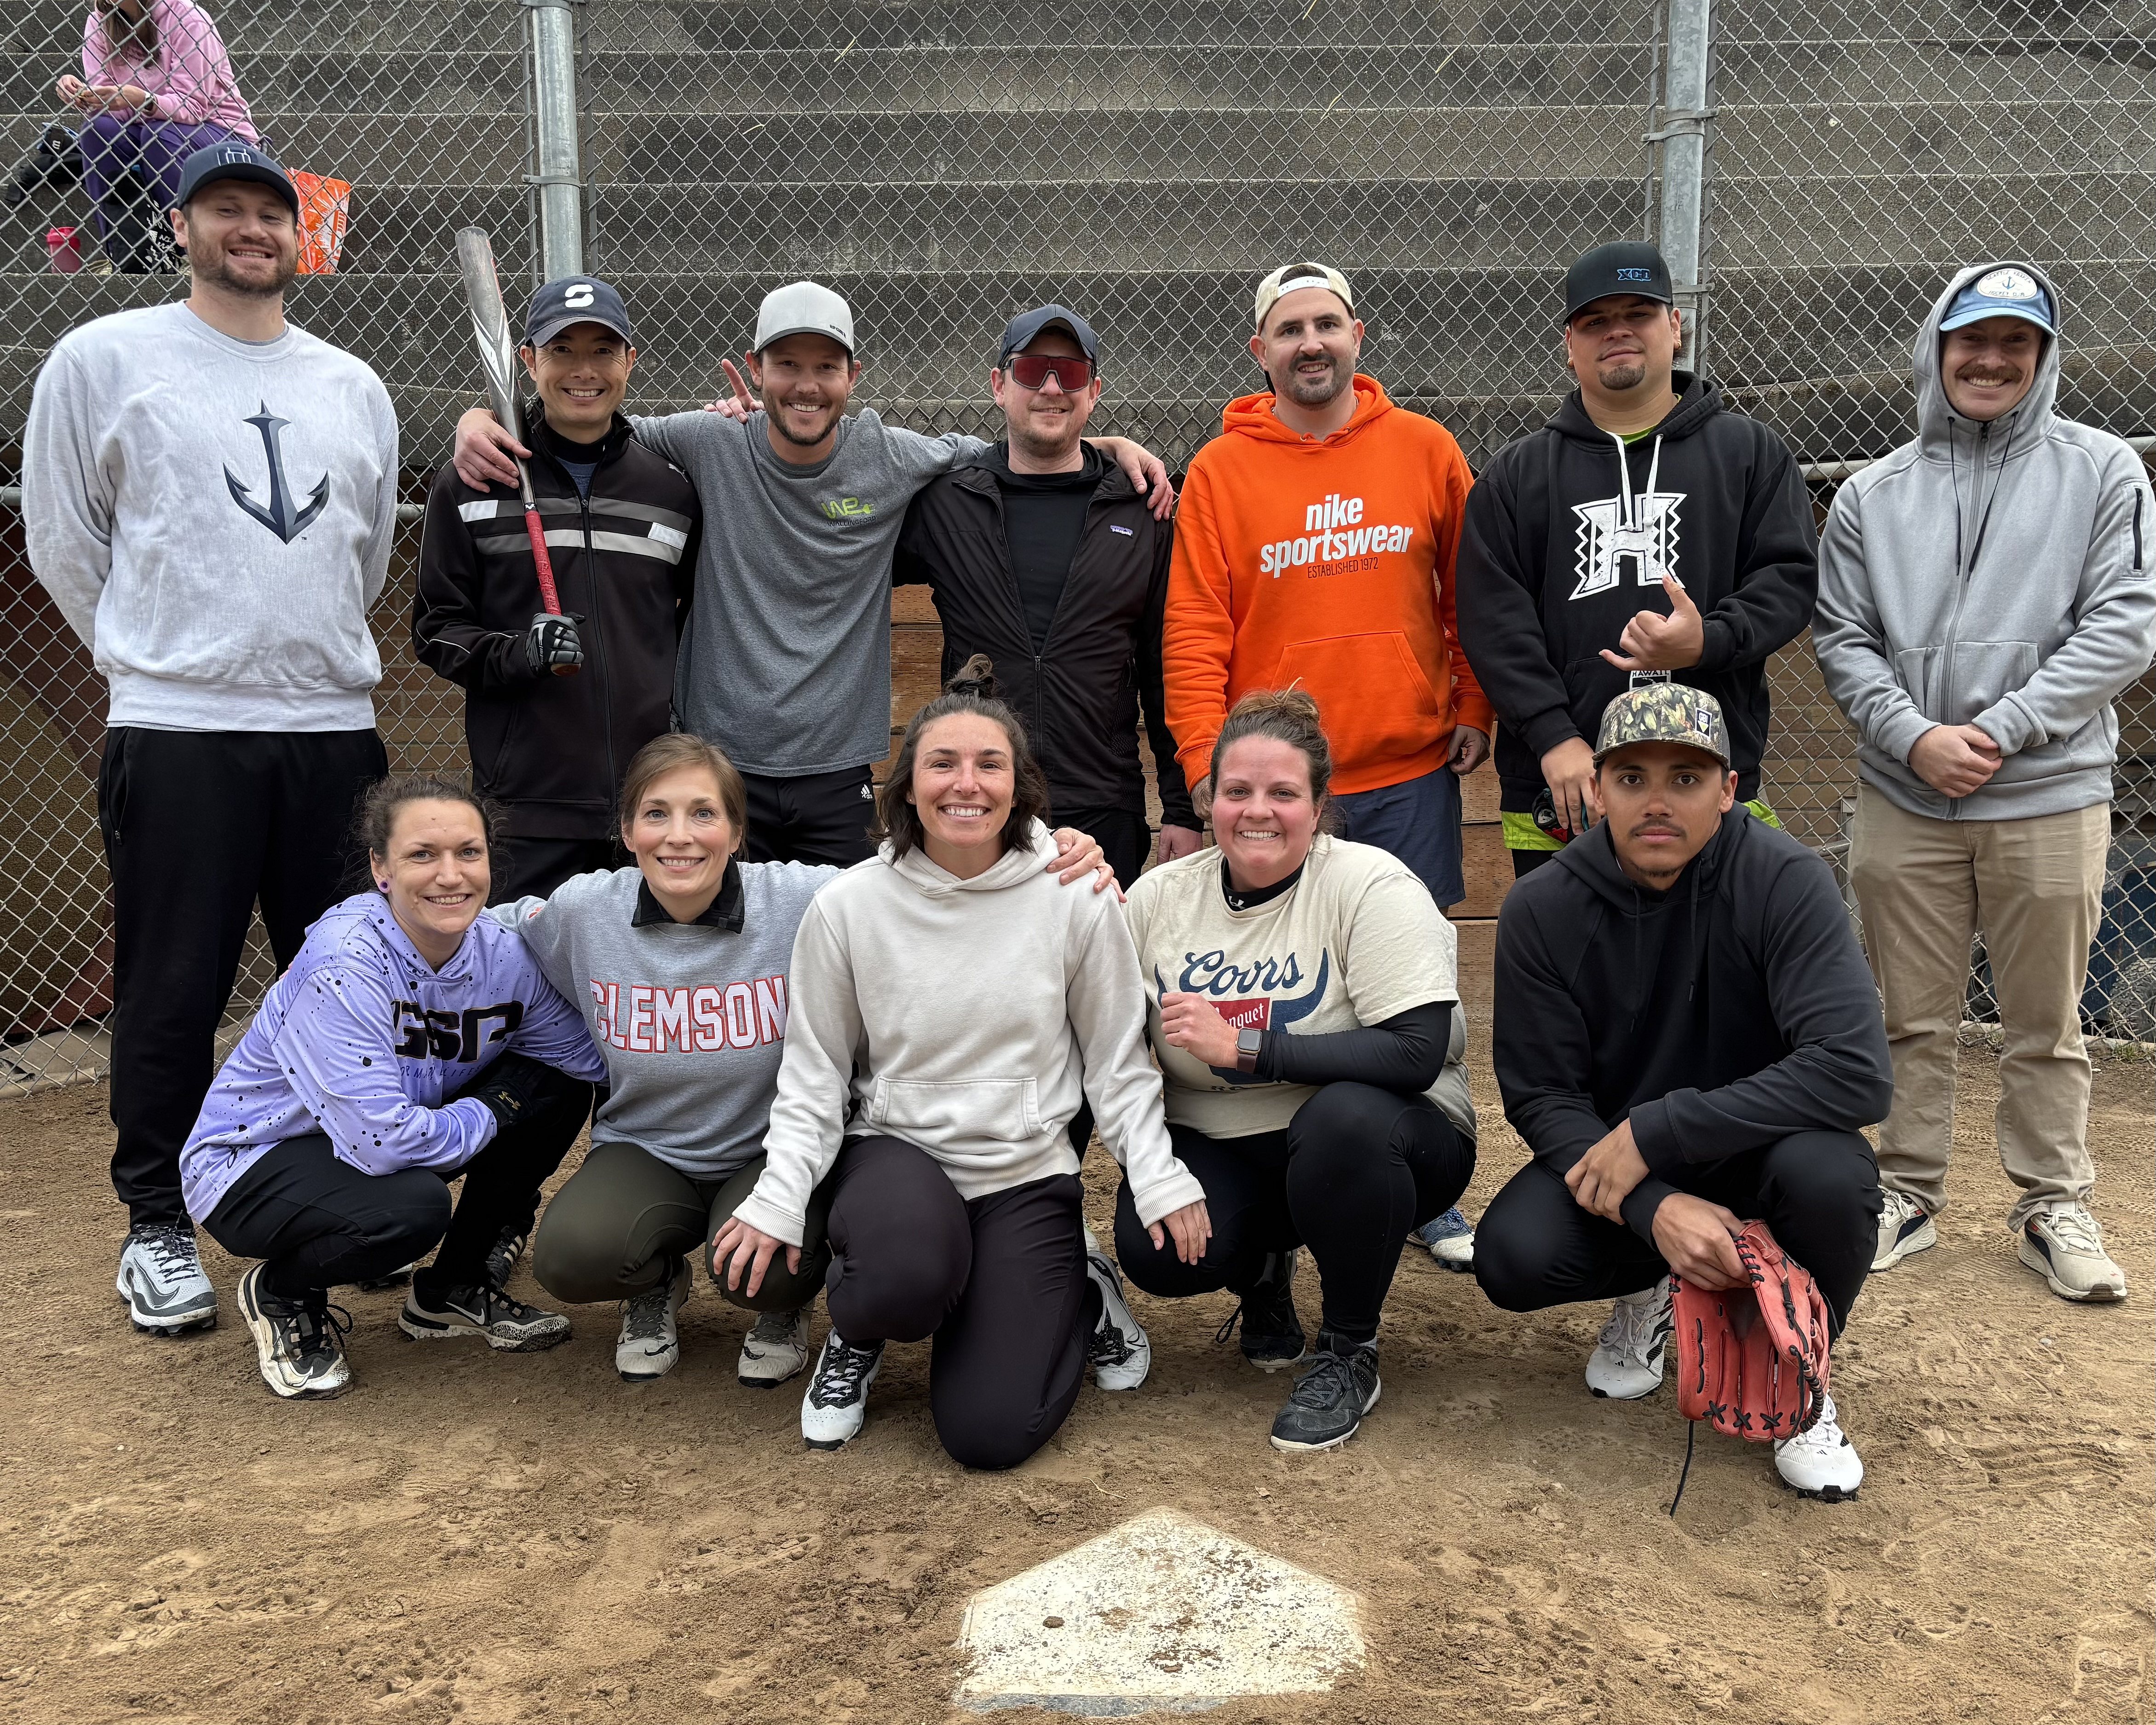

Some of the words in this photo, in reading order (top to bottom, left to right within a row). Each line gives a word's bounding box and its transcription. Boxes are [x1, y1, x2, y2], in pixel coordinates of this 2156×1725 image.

[827, 516, 876, 527] WALLINGFORD
[1305, 494, 1363, 531] nike
[1260, 525, 1413, 579] sportswear
[1308, 559, 1358, 578] ESTABLISHED
[1360, 557, 1379, 570] 1972
[1179, 950, 1304, 995] Coors
[590, 975, 788, 1053] CLEMSON
[1215, 1002, 1264, 1029] nquet
